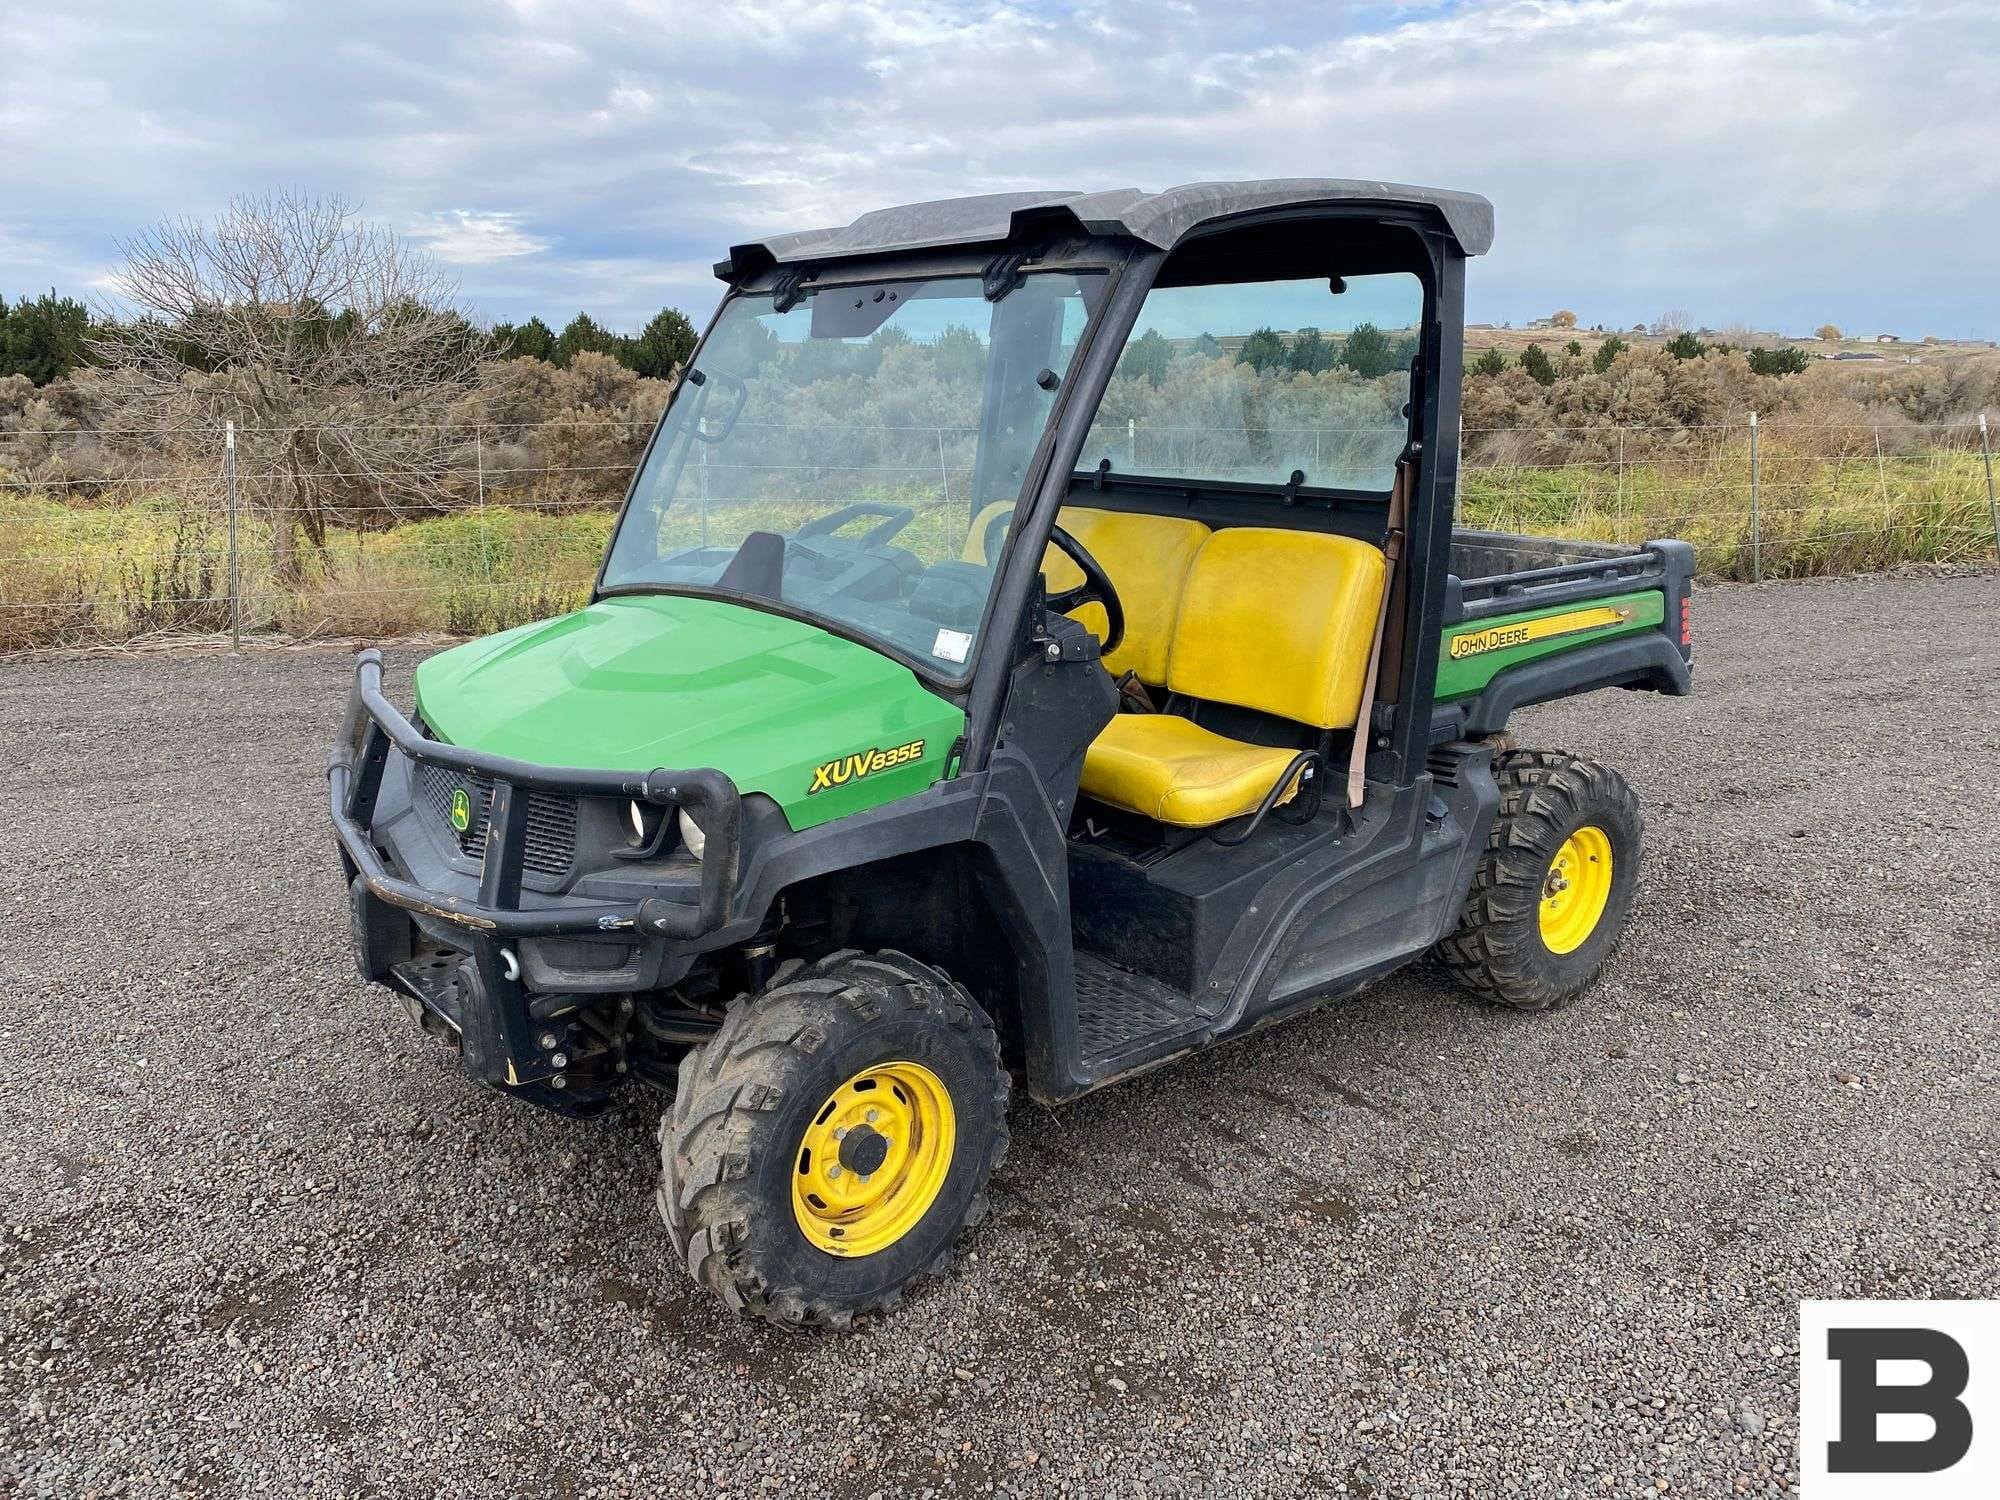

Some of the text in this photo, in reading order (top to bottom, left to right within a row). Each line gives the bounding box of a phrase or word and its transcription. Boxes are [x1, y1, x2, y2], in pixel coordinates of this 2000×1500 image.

[1453, 627, 1529, 655] JOHN DEERE
[808, 740, 925, 794] XUV835E
